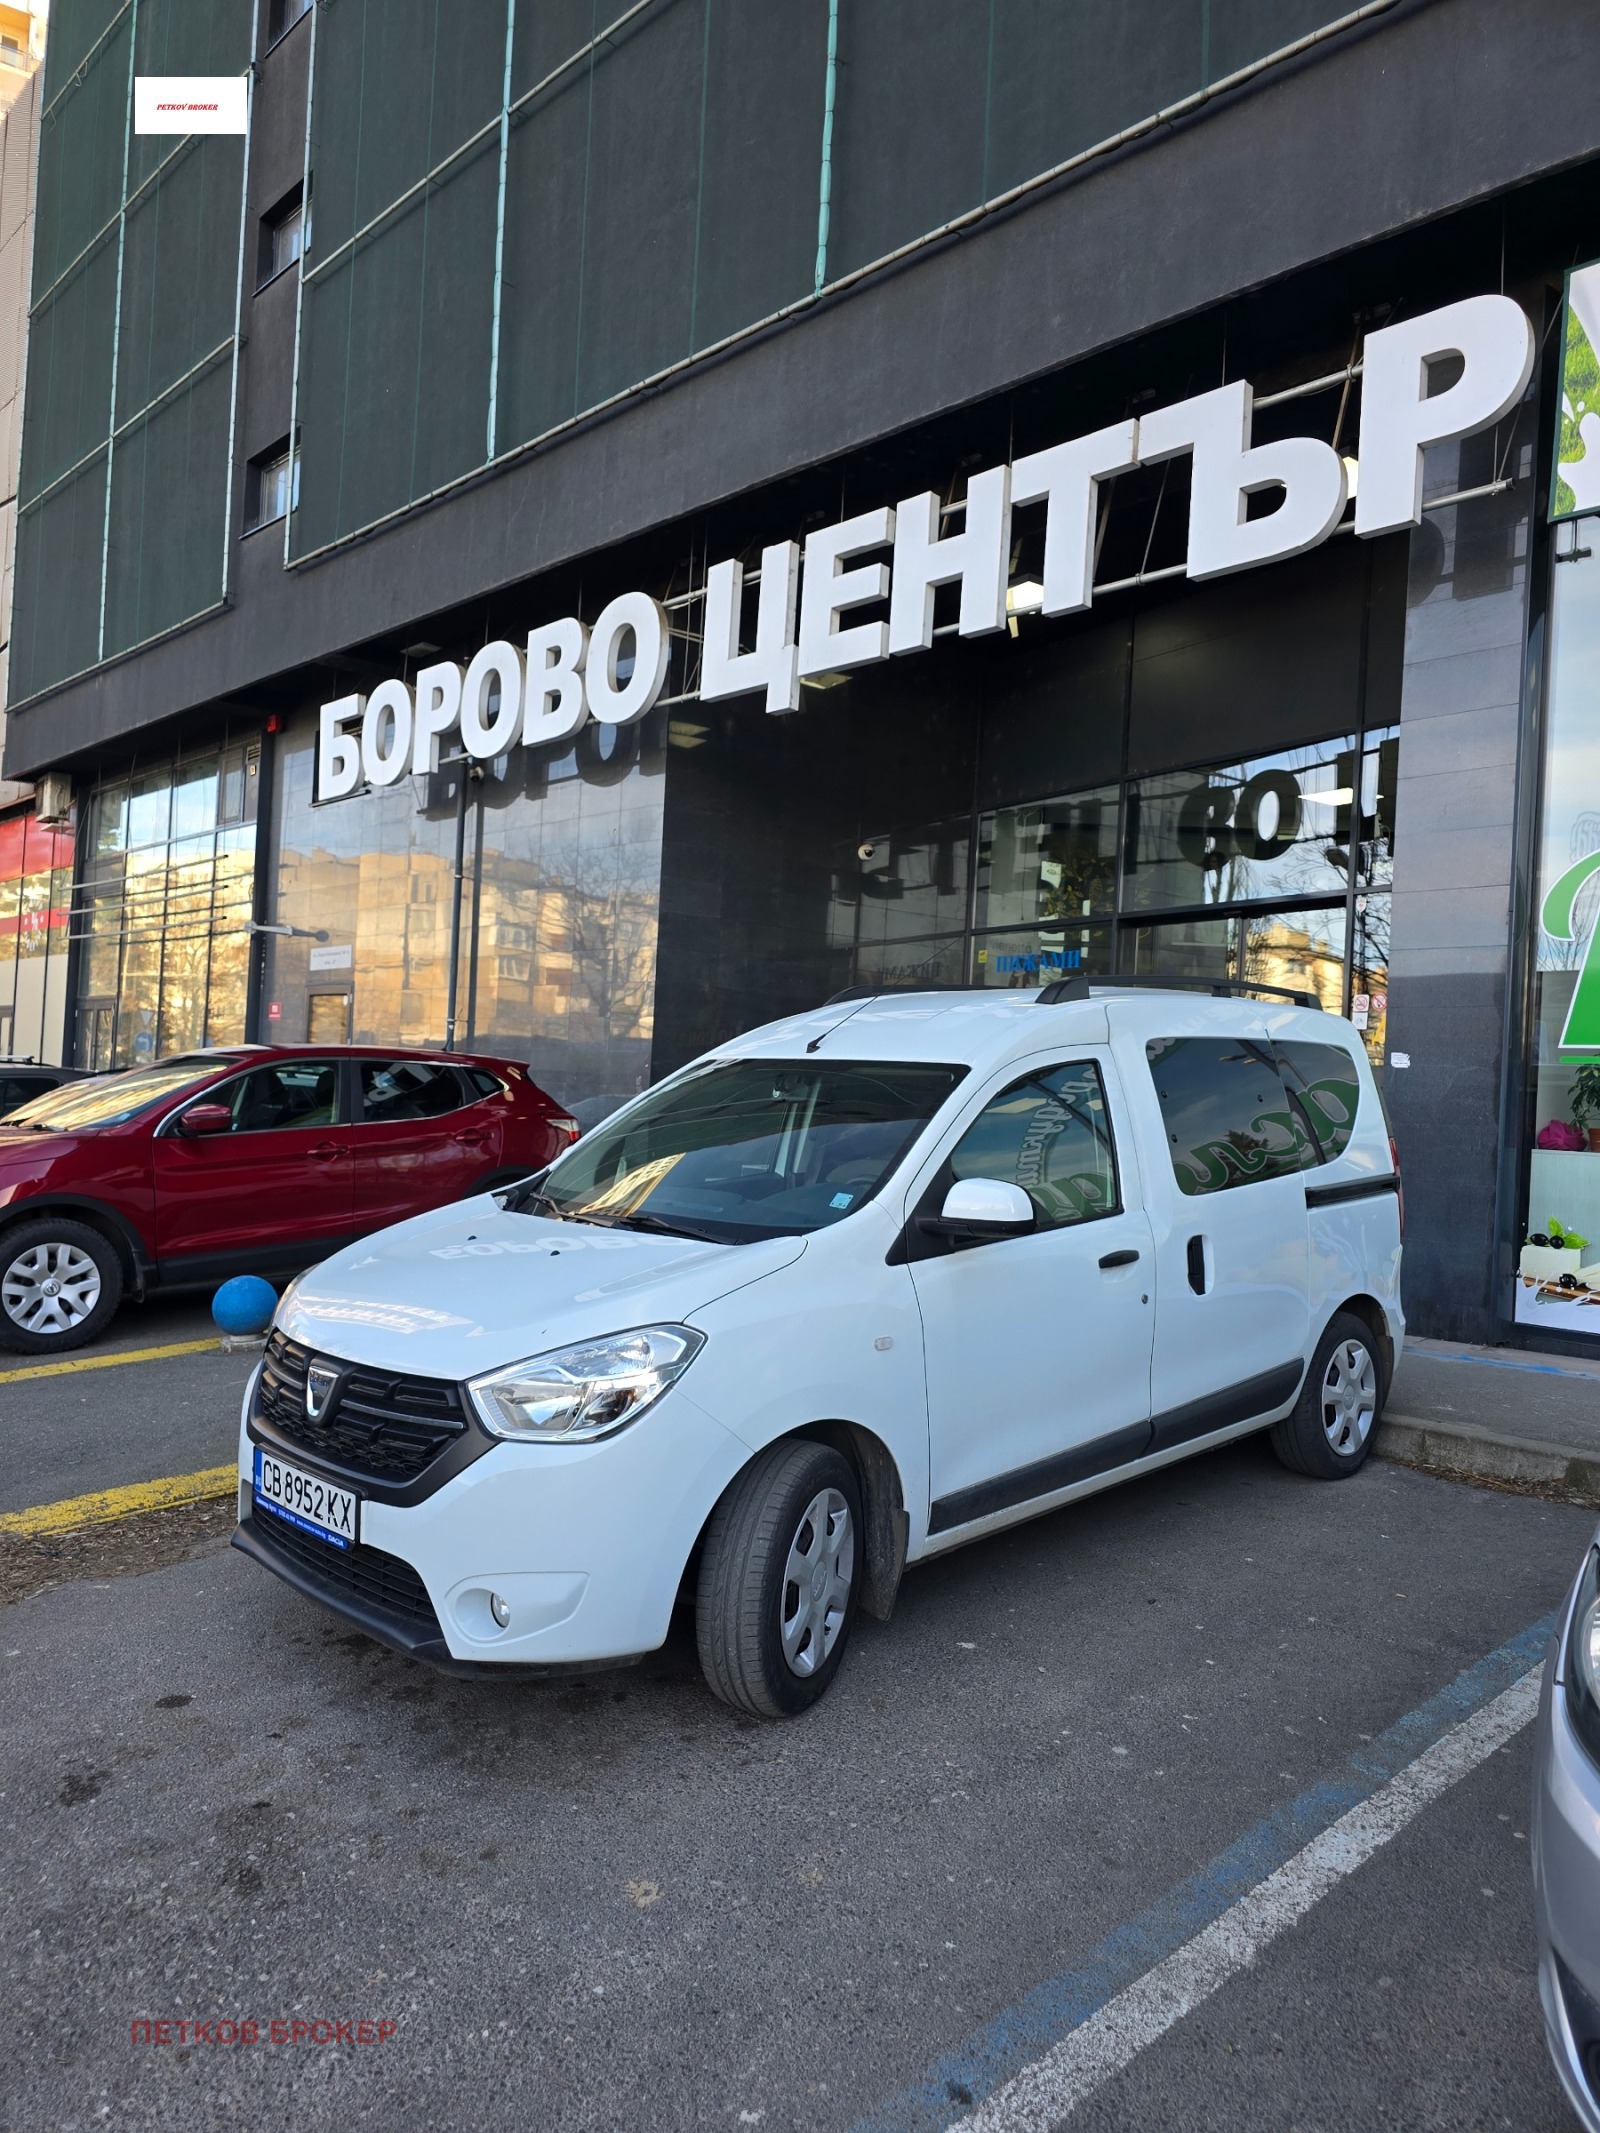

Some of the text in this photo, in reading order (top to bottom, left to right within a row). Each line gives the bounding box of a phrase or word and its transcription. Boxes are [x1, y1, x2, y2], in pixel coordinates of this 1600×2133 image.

[318, 592, 668, 801] БОРОВО
[700, 294, 1536, 716] ЦЕНТЪР
[996, 949, 1081, 973] ПИЖАМИ
